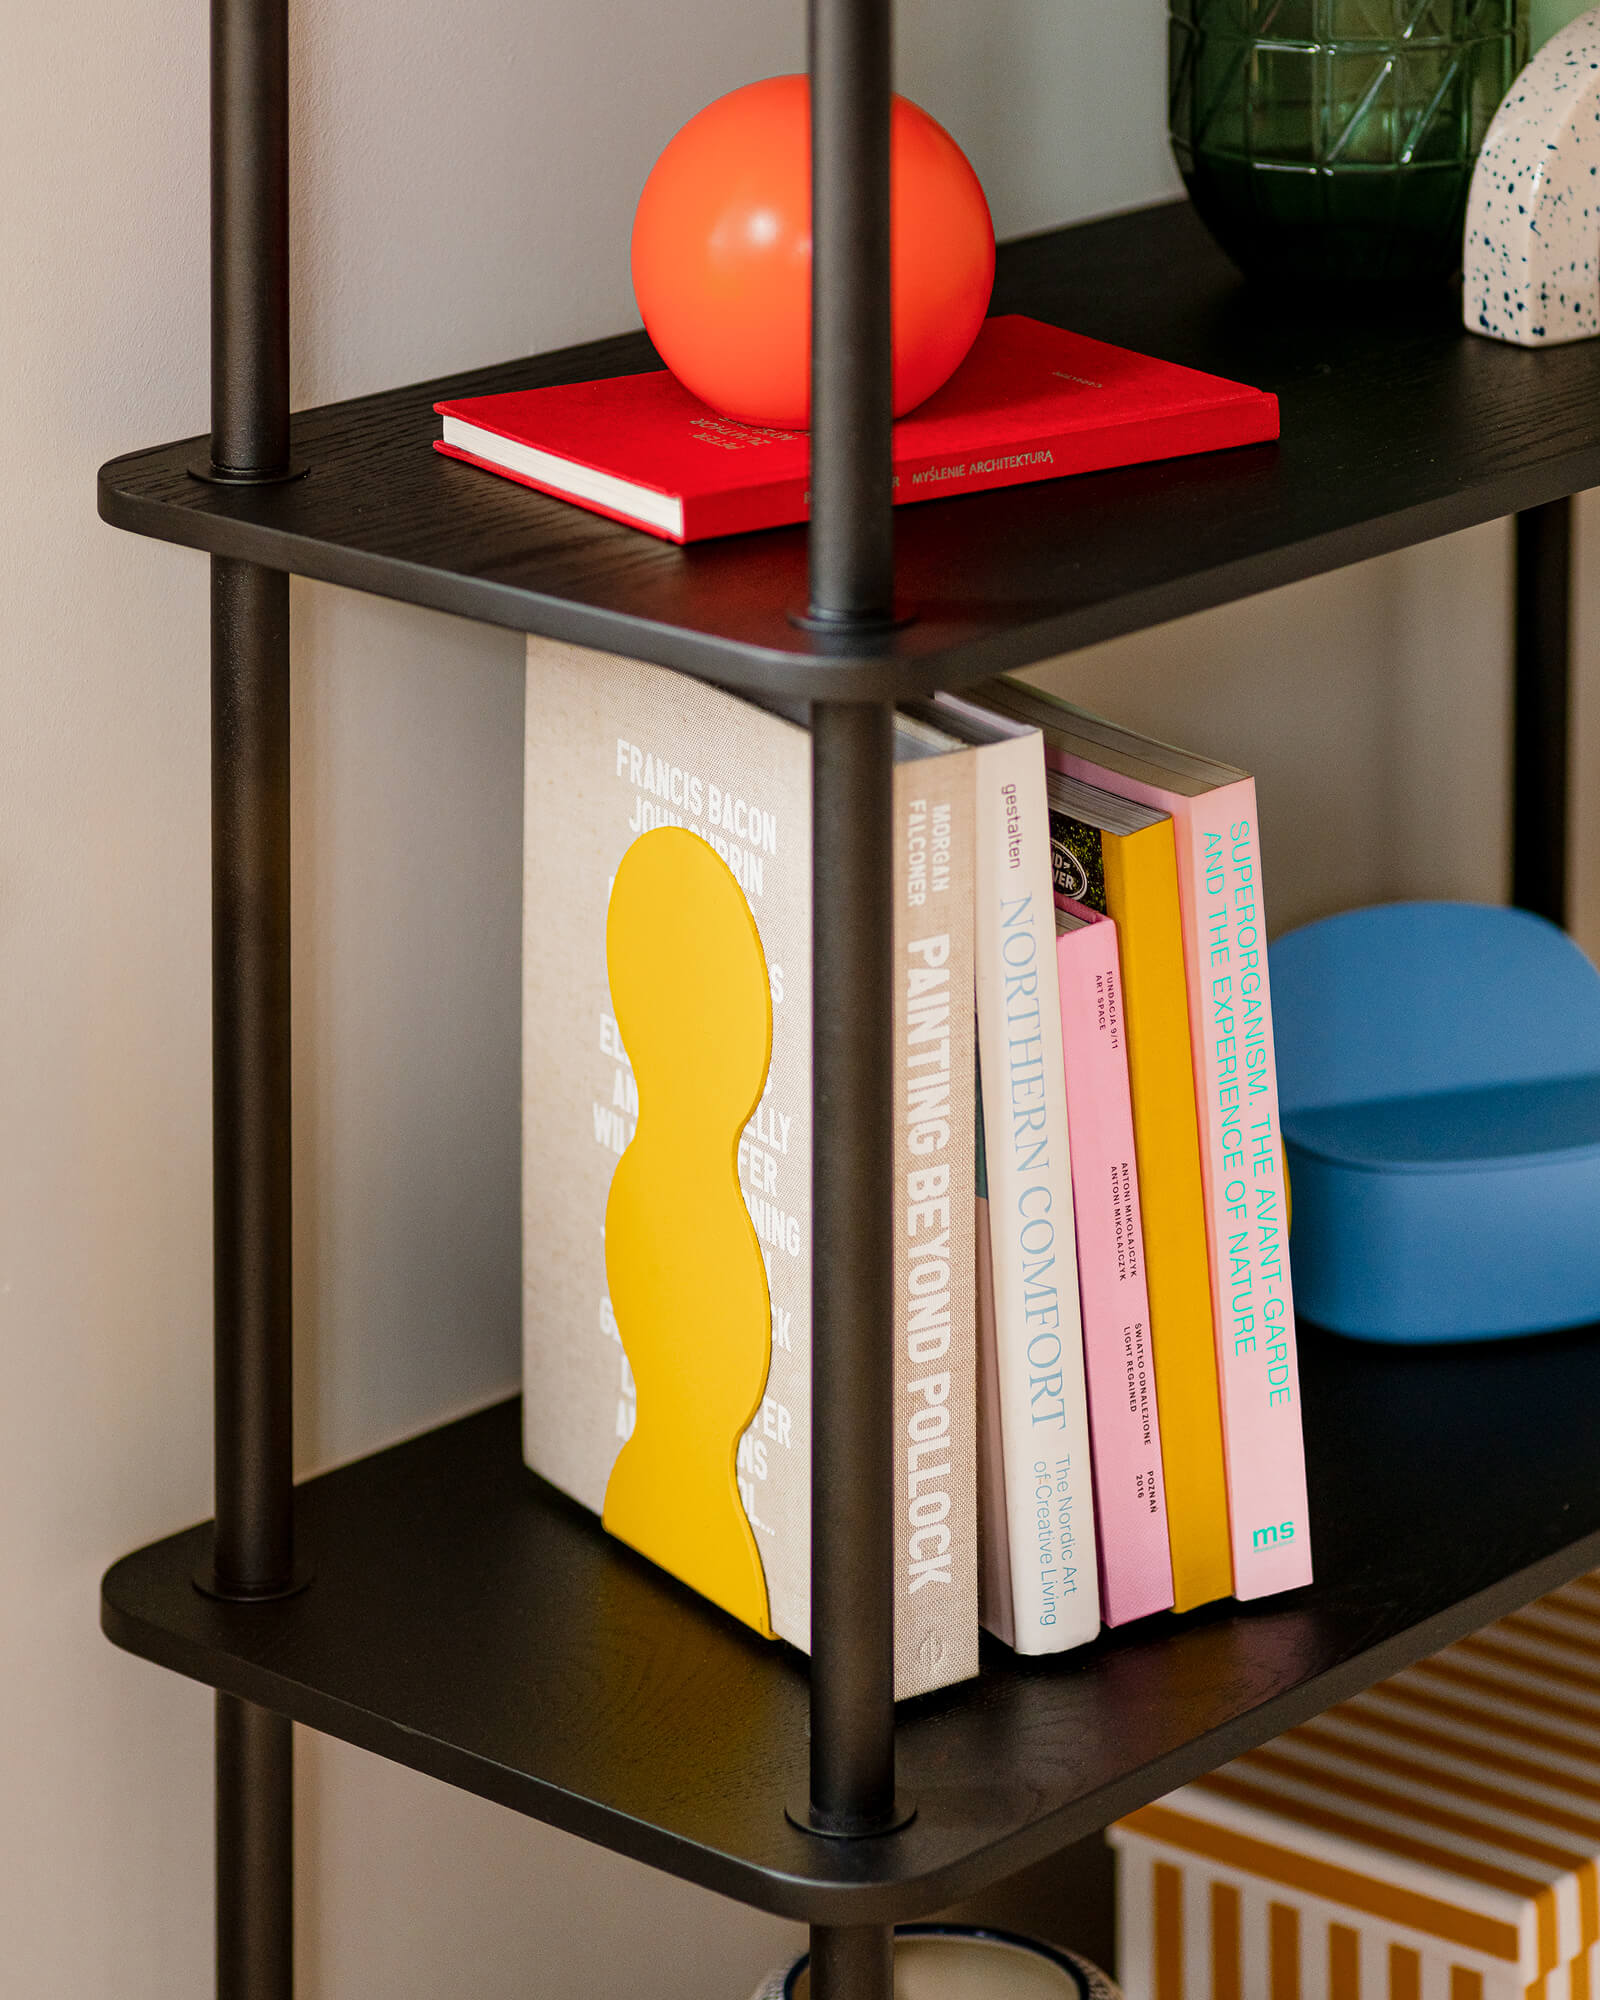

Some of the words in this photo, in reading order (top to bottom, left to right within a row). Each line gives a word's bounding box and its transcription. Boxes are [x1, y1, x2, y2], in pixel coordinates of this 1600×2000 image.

[911, 465, 967, 485] MYŚLENIE
[969, 449, 1055, 474] ARCHITEKTURĄ
[616, 737, 703, 817] FRANCIS
[708, 783, 778, 855] BACON
[1001, 783, 1023, 870] gestalten
[907, 799, 927, 907] FALCONER
[931, 803, 951, 892] MORGAN
[1203, 832, 1226, 896] AND
[1208, 902, 1233, 969] THE
[1229, 820, 1269, 1106] SUPERORGANISM.
[1095, 975, 1104, 994] ART
[1097, 997, 1107, 1031] SPACE
[1106, 970, 1117, 1026] FUNDACJA
[906, 933, 951, 1156] PAINTING
[1000, 890, 1051, 1172] NORTHERN
[1110, 1028, 1119, 1050] 9/11
[1212, 975, 1245, 1172] EXPERIENCE
[1250, 1112, 1276, 1179] THE
[1110, 1165, 1121, 1206] ANTONI
[1121, 1162, 1131, 1202] ANTONI
[1224, 1179, 1249, 1220] OF
[906, 1163, 951, 1364] BEYOND
[1114, 1208, 1127, 1281] MIKOŁAJCZYK
[1124, 1204, 1137, 1278] MIKOŁAJCZYK
[1017, 1185, 1067, 1431] COMFORT
[1227, 1231, 1257, 1357] NATURE
[1254, 1188, 1293, 1408] AVANT-GARDE
[1123, 1326, 1134, 1358] LIGHT
[1134, 1322, 1146, 1370] ŚWIATŁO
[1126, 1360, 1138, 1414] REGAINED
[1137, 1371, 1152, 1446] ODNALEZIONE
[906, 1371, 952, 1595] POLLOCK
[1033, 1460, 1052, 1479] of
[1055, 1452, 1071, 1493] The
[1135, 1474, 1145, 1500] 2016
[1147, 1470, 1157, 1514] POZNAŃ
[1034, 1484, 1055, 1566] Creative
[1057, 1495, 1076, 1561] Nordic
[1252, 1520, 1296, 1548] ms
[1039, 1568, 1061, 1627] Living
[1062, 1565, 1078, 1597] Art
